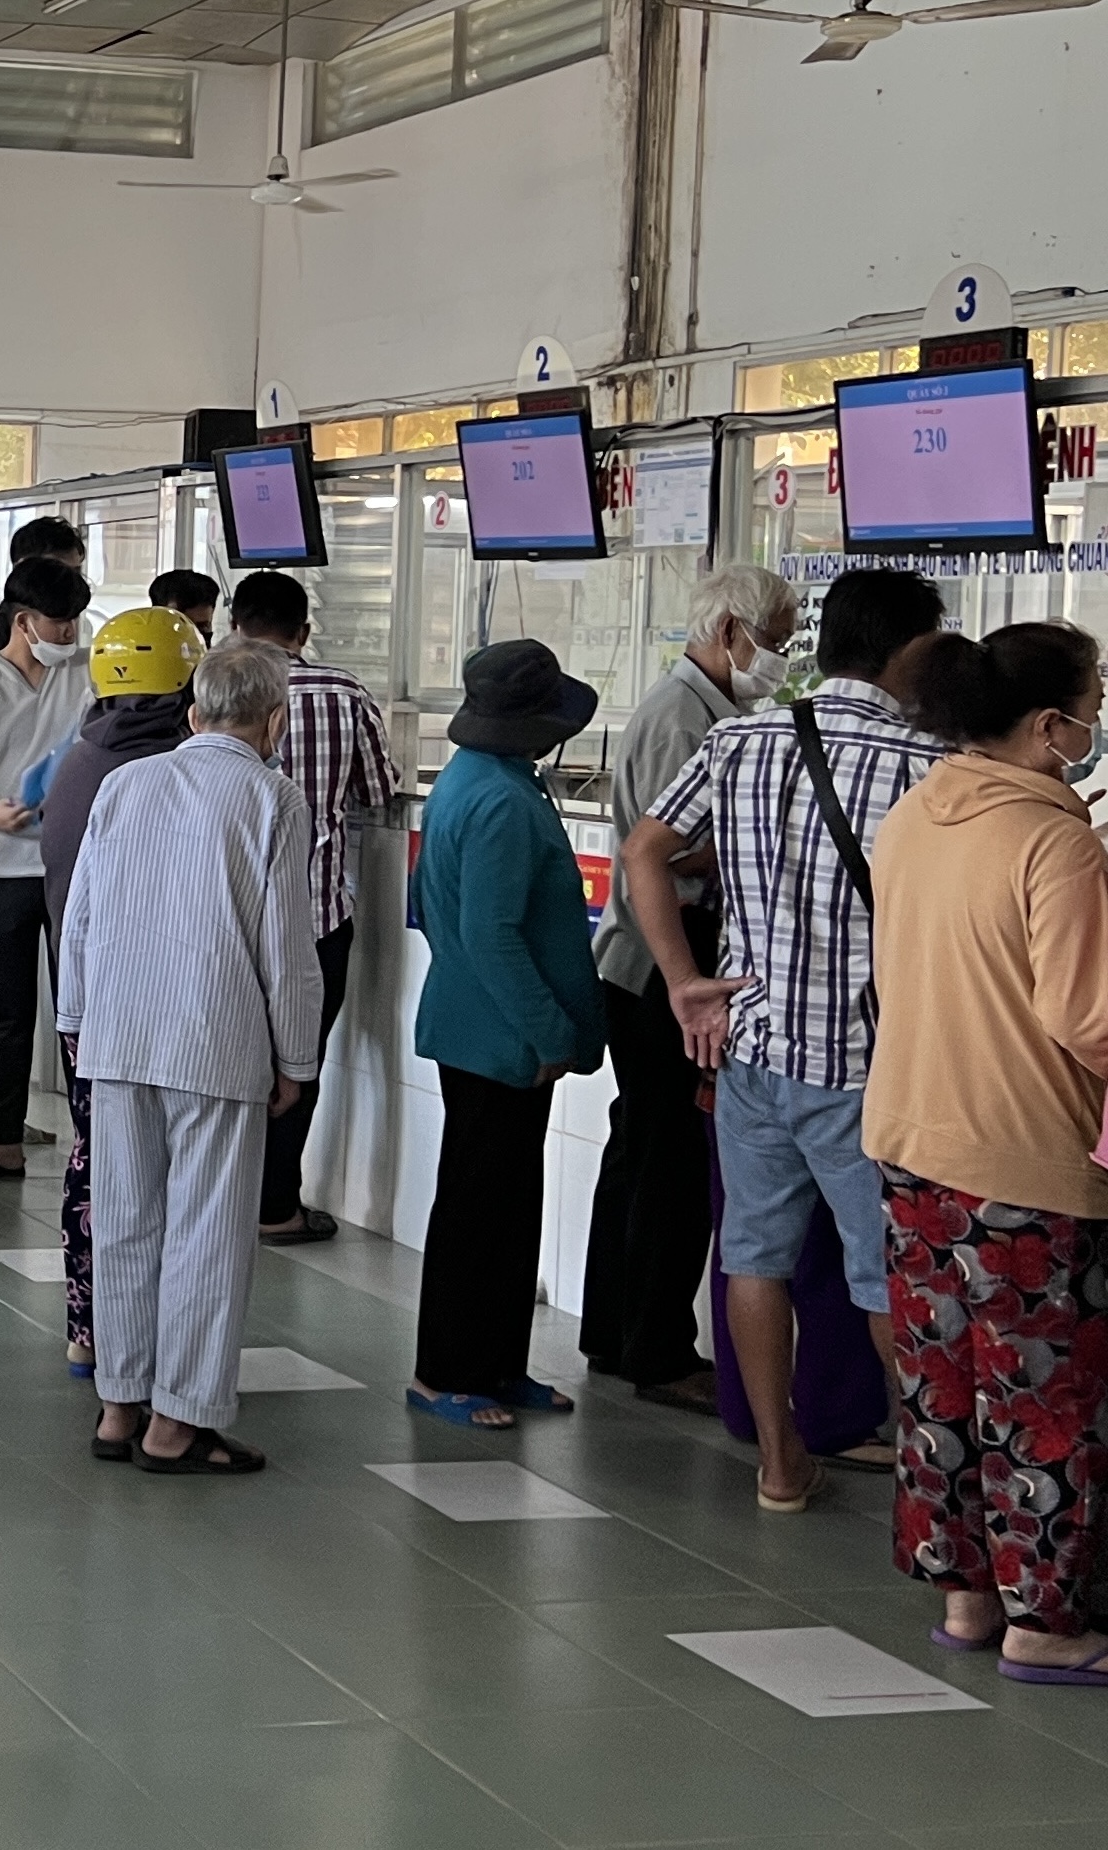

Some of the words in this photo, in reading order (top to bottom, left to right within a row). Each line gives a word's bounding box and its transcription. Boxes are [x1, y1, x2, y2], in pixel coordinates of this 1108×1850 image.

[955, 276, 977, 323] 3
[535, 345, 551, 382] 2
[270, 387, 279, 419] 1
[913, 427, 947, 453] 230
[1042, 412, 1096, 493] ỆNH
[512, 460, 535, 481] 202
[775, 469, 788, 505] 3
[435, 496, 446, 526] 2
